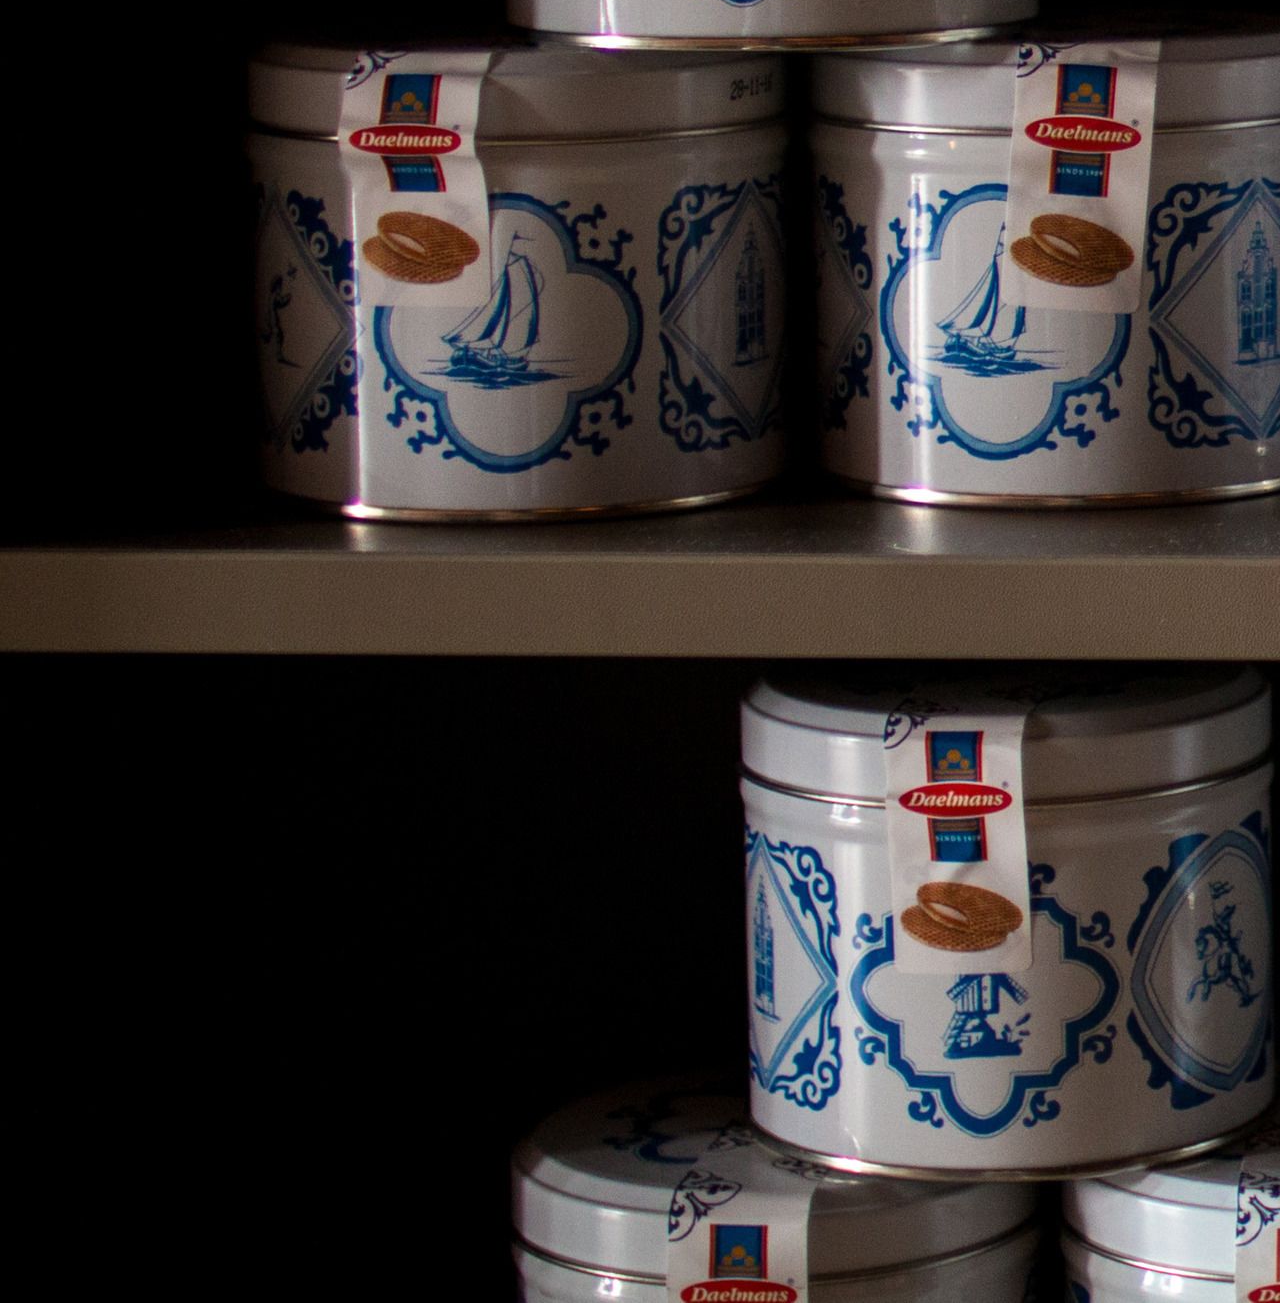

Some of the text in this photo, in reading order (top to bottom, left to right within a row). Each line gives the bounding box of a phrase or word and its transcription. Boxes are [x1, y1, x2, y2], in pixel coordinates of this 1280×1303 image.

[360, 132, 453, 147] Daelmans
[1036, 123, 1133, 143] Daelmans
[908, 790, 1003, 807] Daelmans
[691, 1288, 788, 1303] Daelmans
